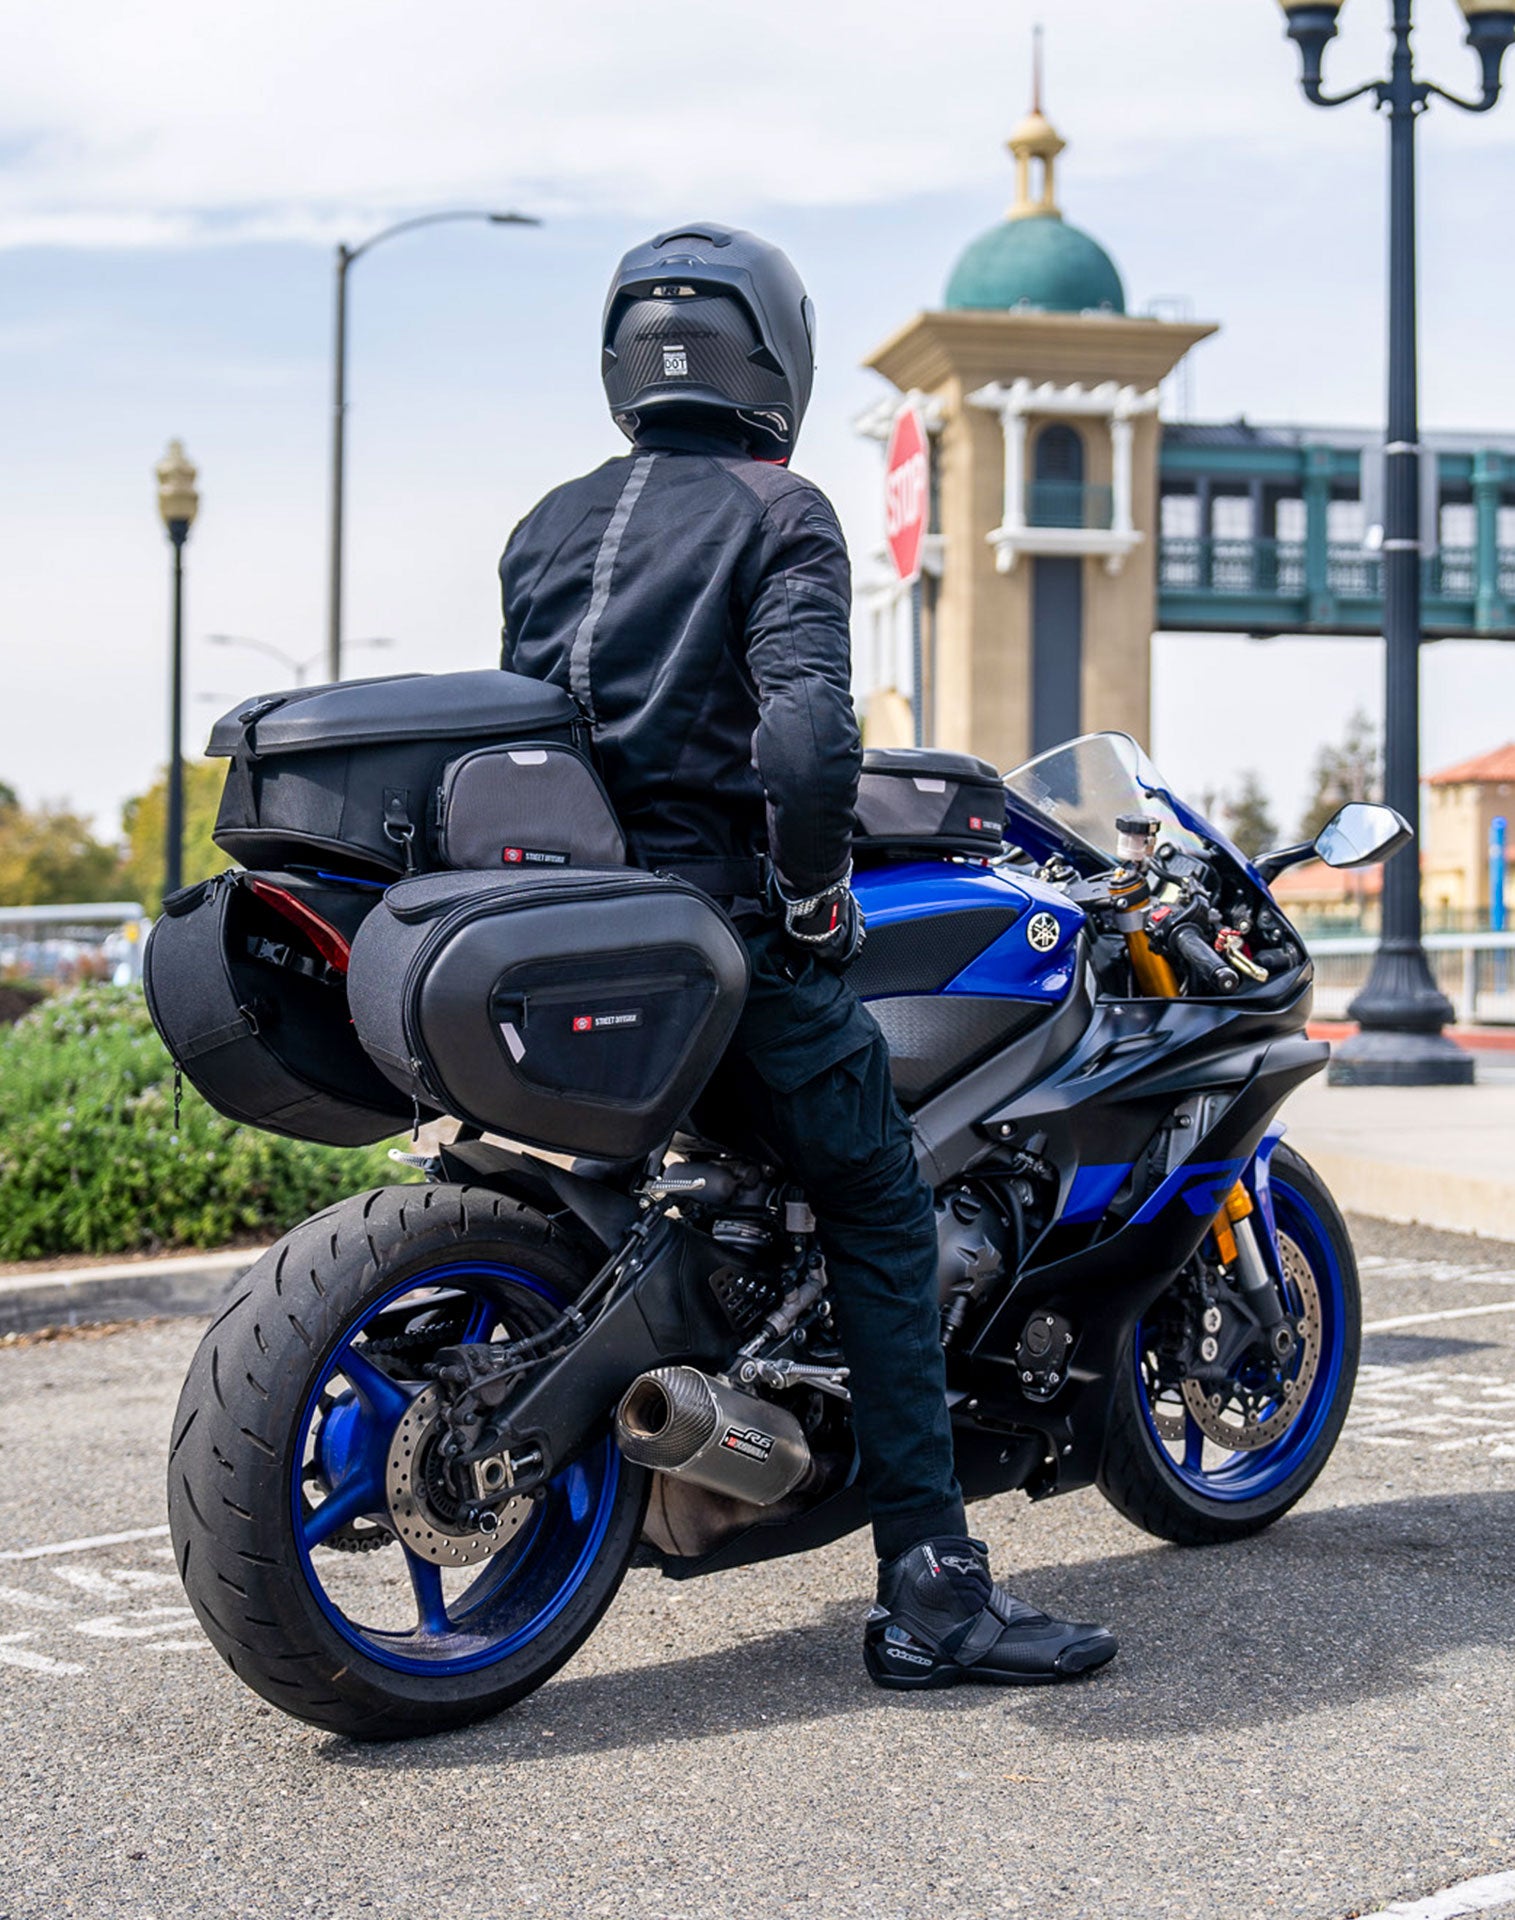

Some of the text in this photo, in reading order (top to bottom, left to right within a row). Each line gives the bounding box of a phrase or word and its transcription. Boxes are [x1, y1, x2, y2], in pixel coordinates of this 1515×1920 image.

[664, 359, 686, 369] DOT
[887, 452, 926, 536] STOP
[744, 1432, 771, 1449] R6
